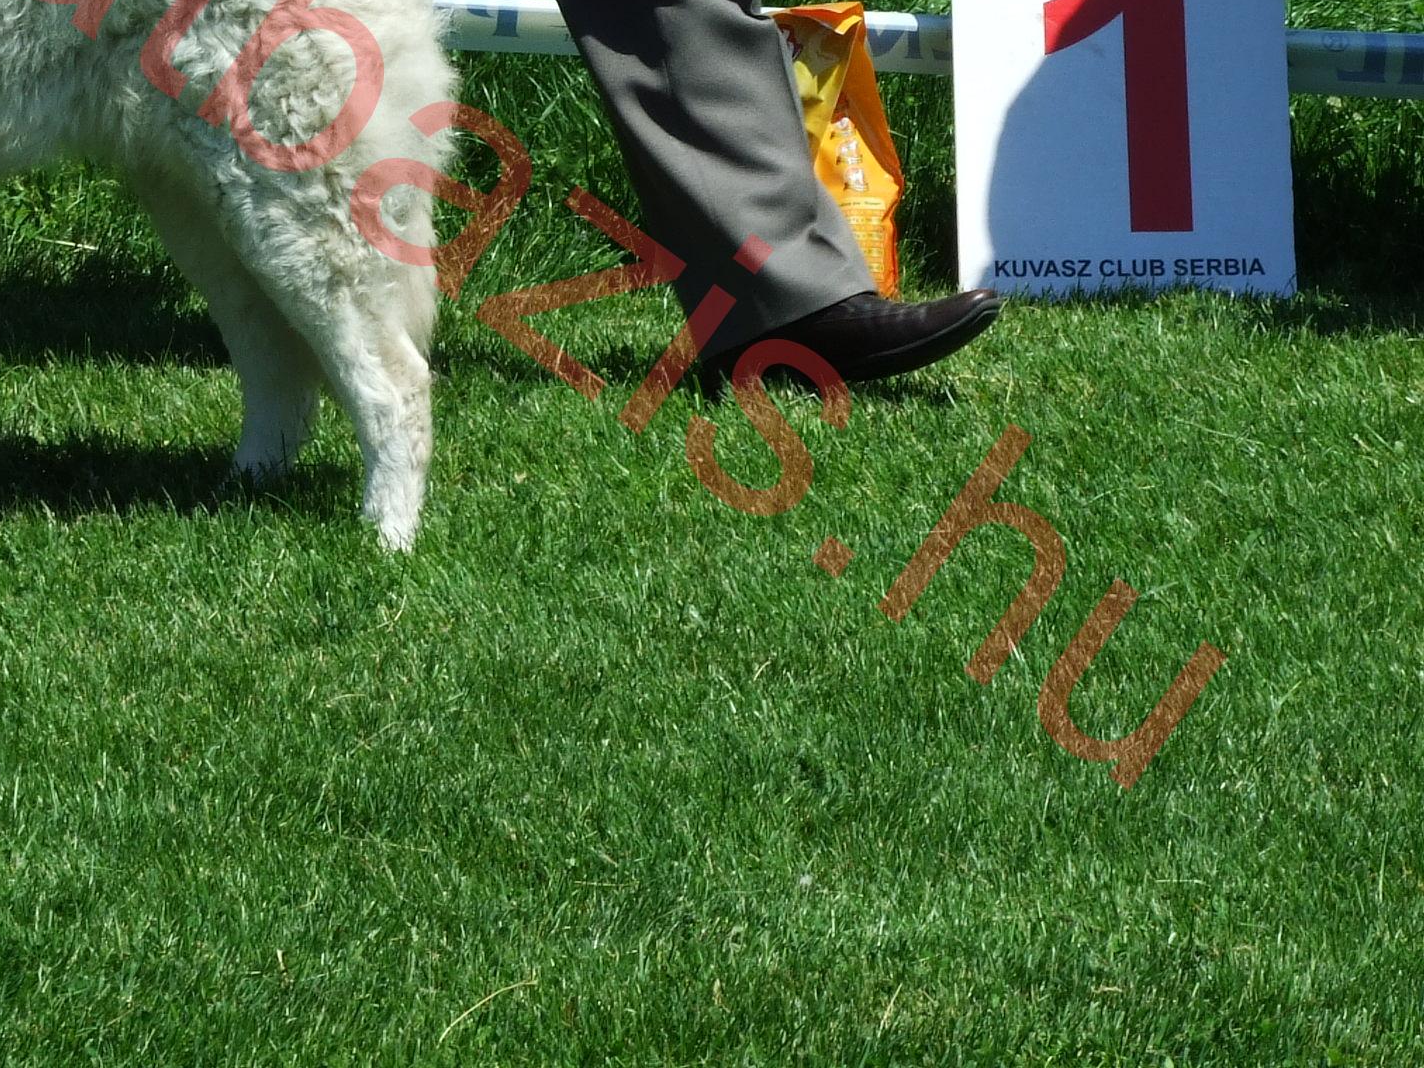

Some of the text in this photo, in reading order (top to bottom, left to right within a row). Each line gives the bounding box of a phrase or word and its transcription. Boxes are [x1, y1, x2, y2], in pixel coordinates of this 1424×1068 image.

[995, 258, 1266, 278] KUVASZ CLUB SERBIA
